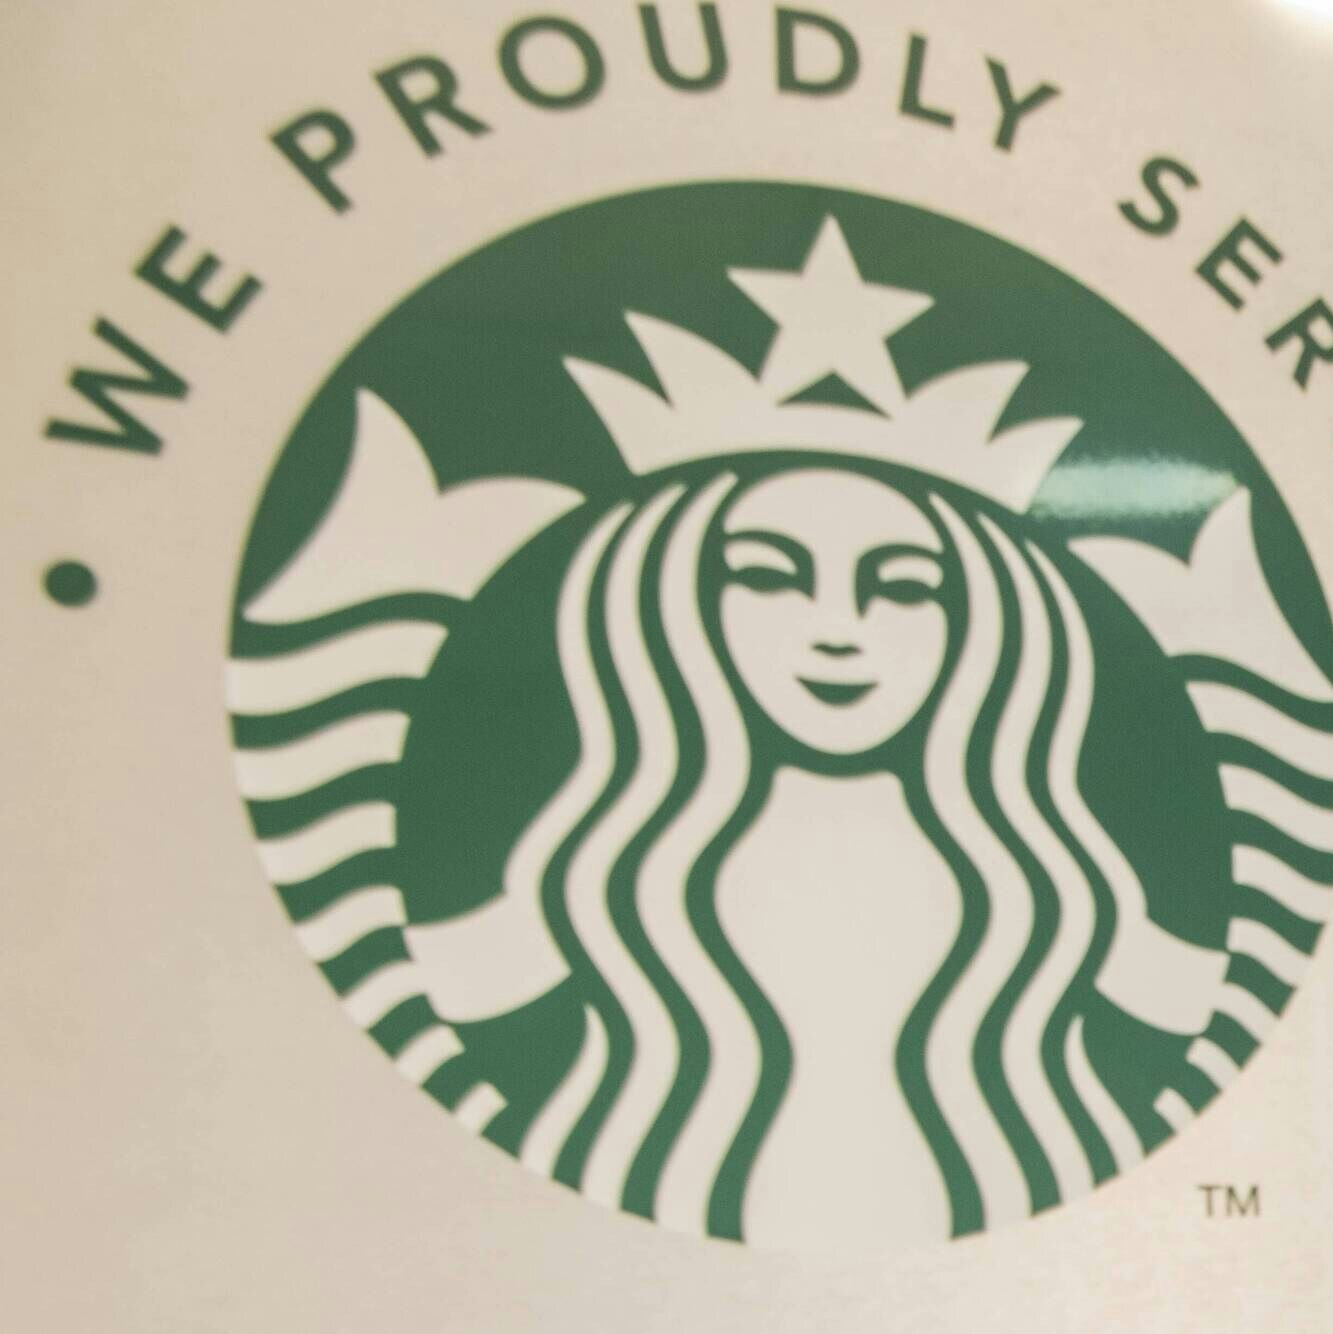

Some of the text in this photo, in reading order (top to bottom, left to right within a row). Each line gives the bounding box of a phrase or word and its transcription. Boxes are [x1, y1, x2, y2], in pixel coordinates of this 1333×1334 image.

[42, 224, 264, 458] WE
[269, 2, 1060, 215] PROUDLY
[1199, 1185, 1261, 1219] TM
